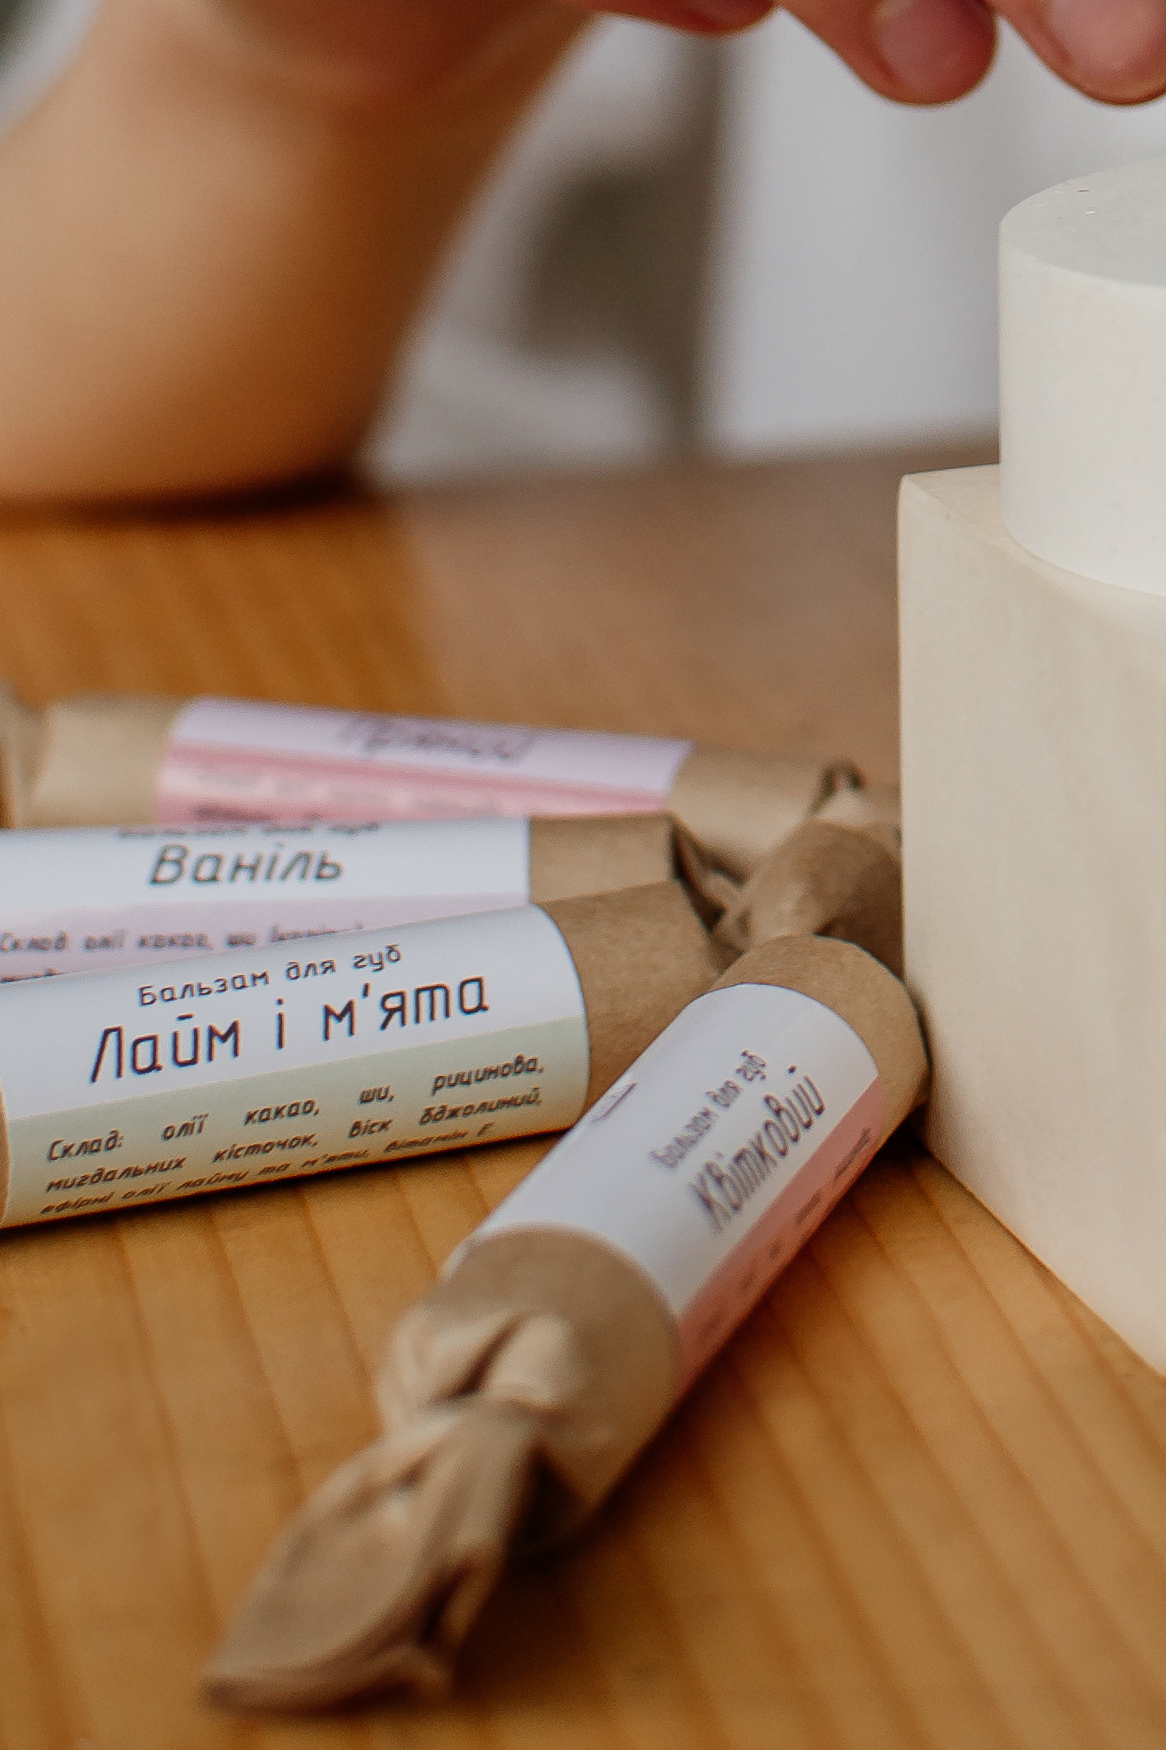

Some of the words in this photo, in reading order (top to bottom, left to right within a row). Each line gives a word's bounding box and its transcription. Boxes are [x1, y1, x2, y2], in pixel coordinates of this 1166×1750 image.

[149, 843, 345, 885] Ваніль
[140, 970, 270, 1006] Бальзам
[285, 957, 337, 982] для
[352, 944, 403, 976] губ
[90, 1013, 240, 1084] Лайм
[275, 998, 286, 1050] і
[323, 976, 490, 1042] м'ята
[735, 1049, 767, 1081] губ
[46, 1157, 187, 1192] мигдальних
[213, 1133, 318, 1163] кісточок,
[349, 1119, 393, 1139] віск
[419, 1086, 543, 1125] бджолиний,
[47, 1129, 125, 1161] Склад:
[161, 1113, 209, 1141] олії
[244, 1099, 320, 1126] какао,
[359, 1085, 394, 1105] ши,
[431, 1054, 545, 1096] рицинова,
[258, 1161, 291, 1176] та
[687, 1065, 825, 1236] Квітковий
